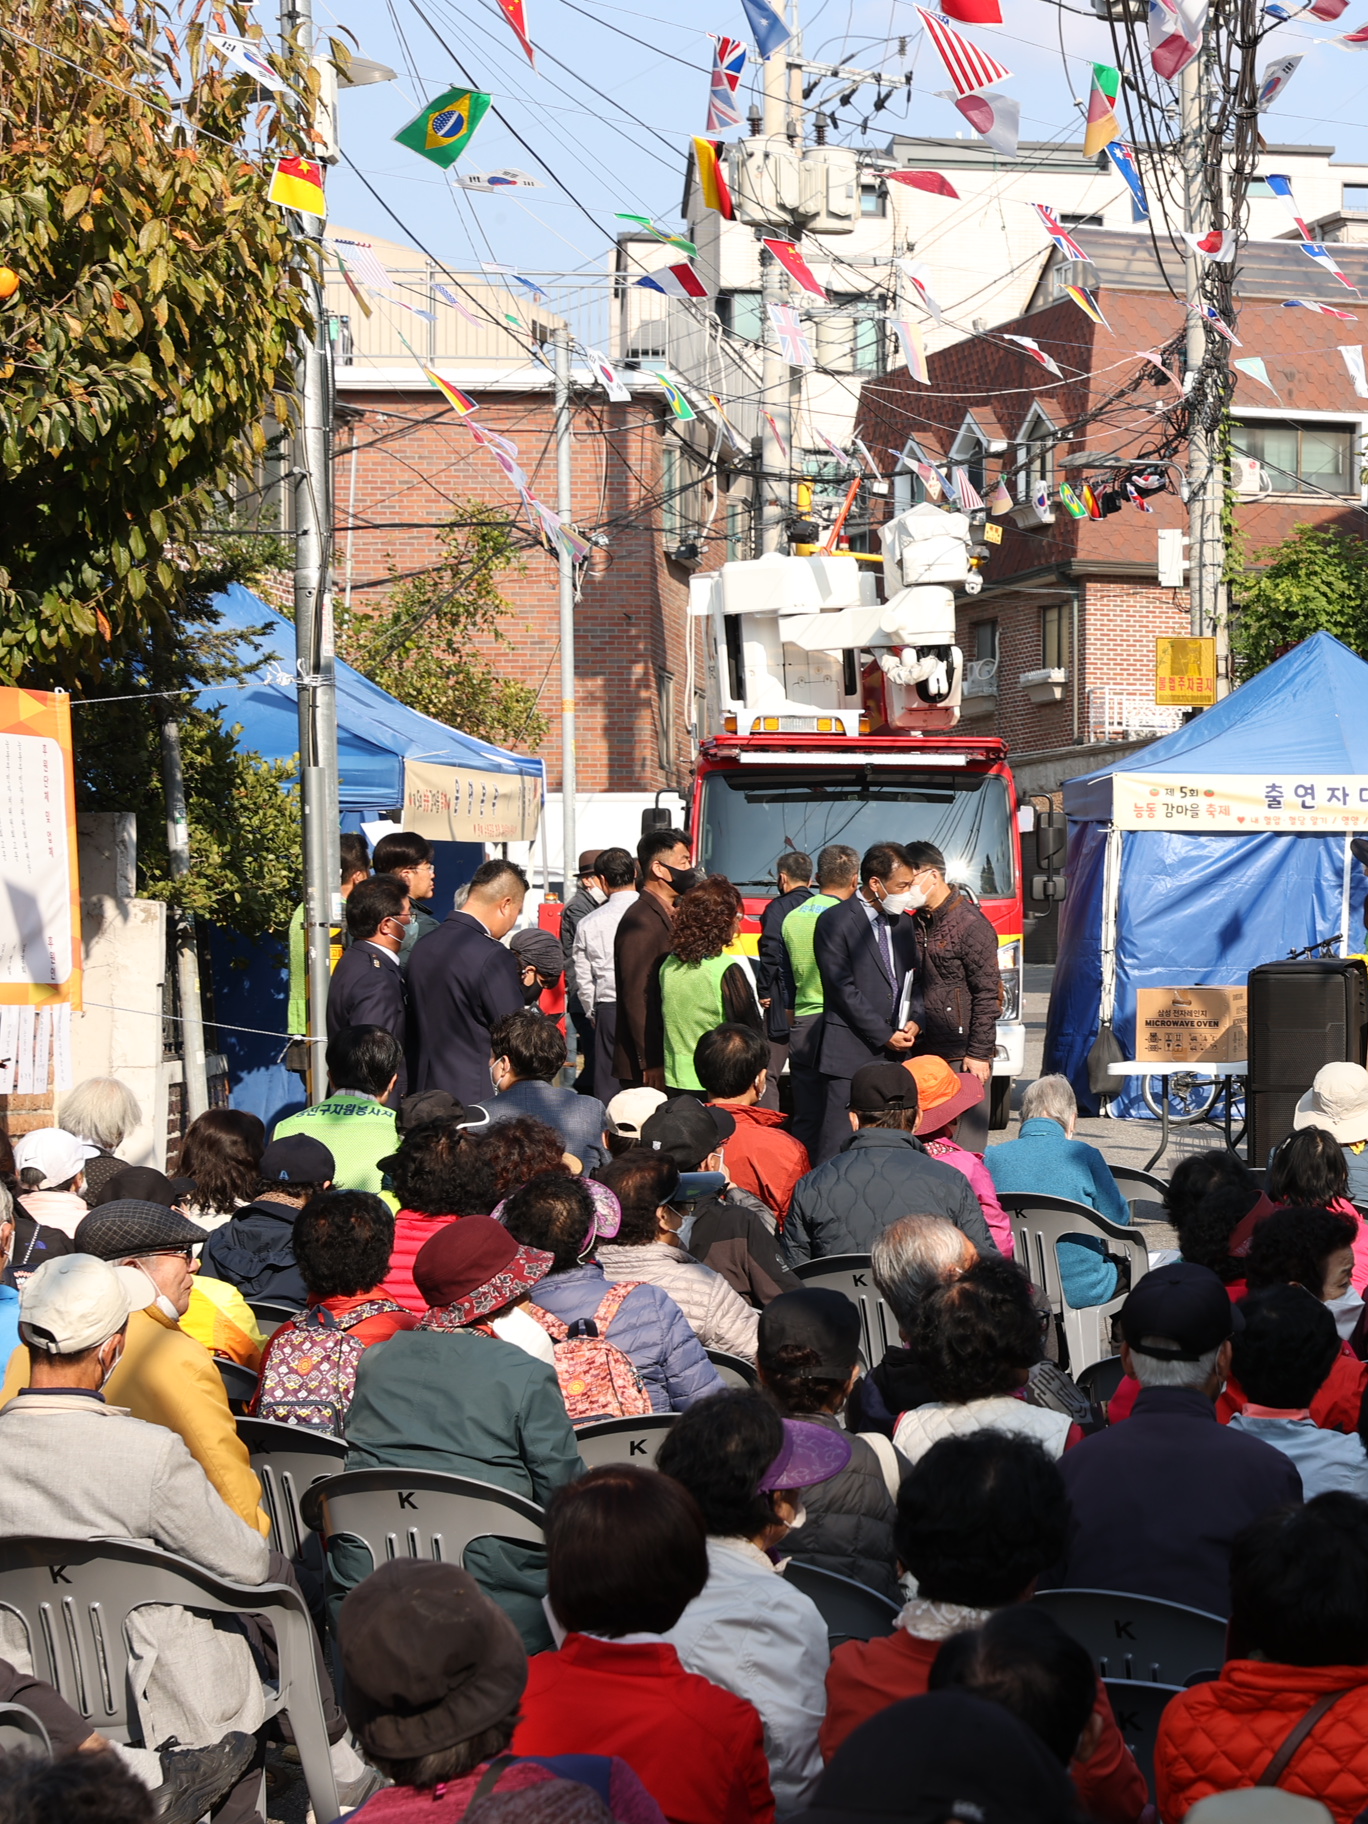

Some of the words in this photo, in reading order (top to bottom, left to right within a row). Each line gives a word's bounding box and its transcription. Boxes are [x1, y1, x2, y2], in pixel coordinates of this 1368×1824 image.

[1165, 788, 1174, 797] 제
[1180, 786, 1199, 798] 5회
[1134, 803, 1157, 818] 능동
[1162, 803, 1200, 818] 감마을
[1206, 803, 1231, 818] 축제
[1014, 1208, 1027, 1218] K
[852, 1273, 868, 1287] K
[253, 1439, 271, 1454] K
[629, 1438, 648, 1456] K
[397, 1491, 419, 1509] K
[49, 1563, 72, 1584] K
[1114, 1620, 1136, 1640] K
